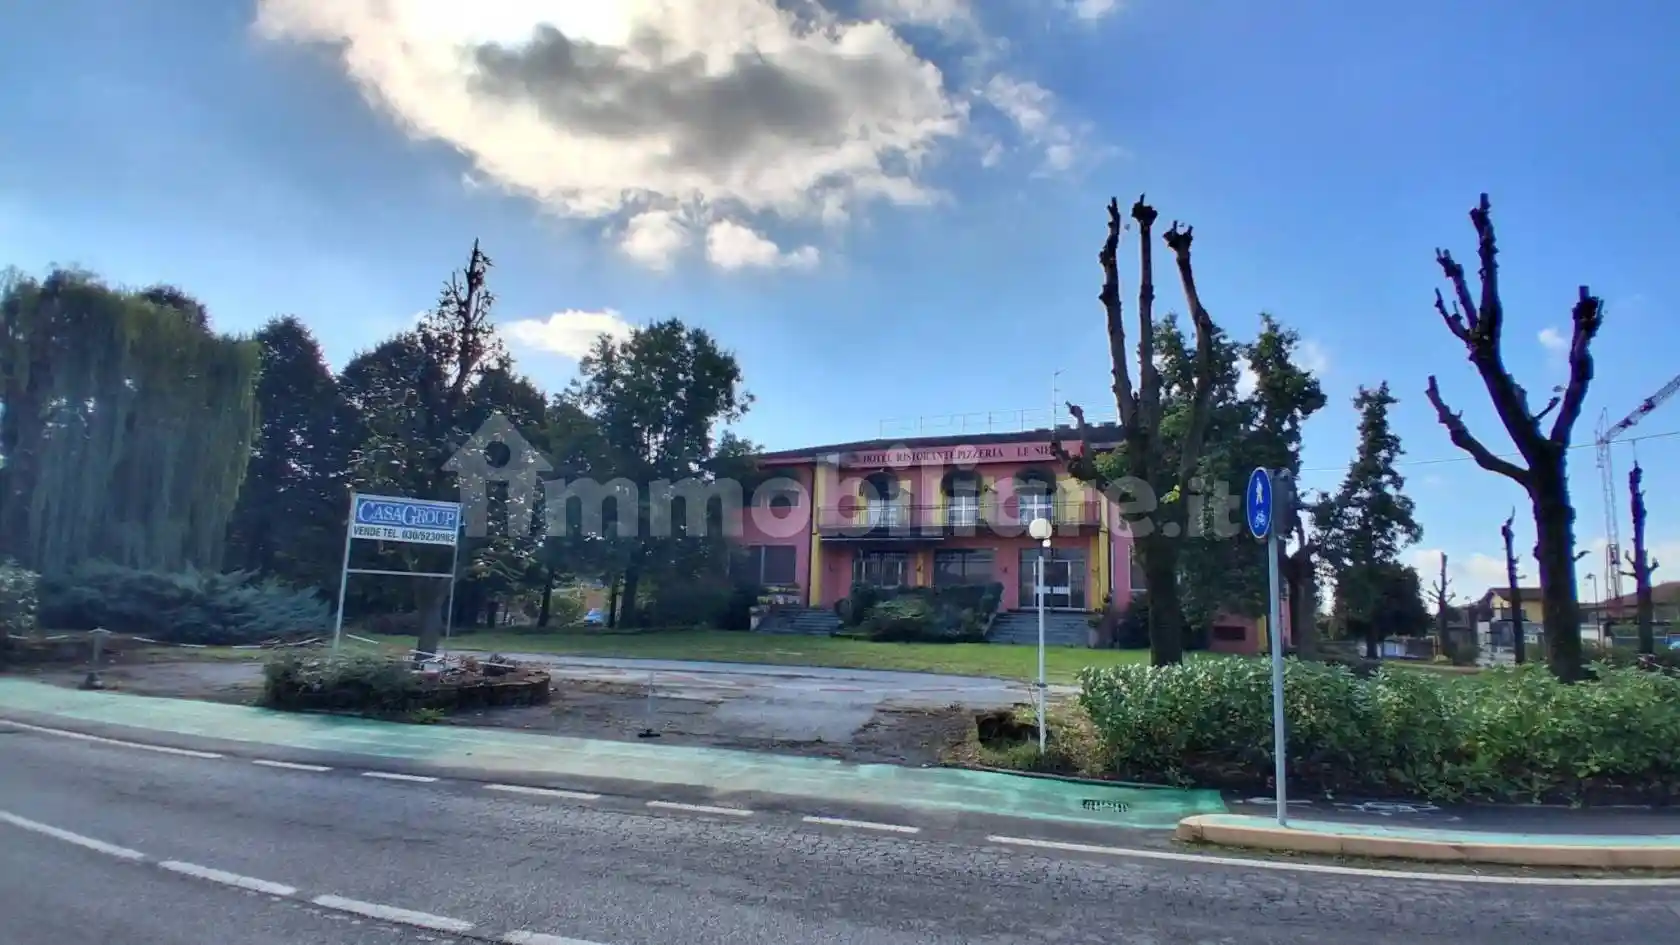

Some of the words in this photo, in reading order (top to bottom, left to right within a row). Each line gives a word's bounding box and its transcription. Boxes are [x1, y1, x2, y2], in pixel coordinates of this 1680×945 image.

[863, 454, 893, 463] HOTEL
[896, 450, 954, 462] RISTORANTE
[958, 447, 1004, 460] PIZZERIA
[1017, 446, 1029, 457] LE
[353, 525, 382, 537] VENDE
